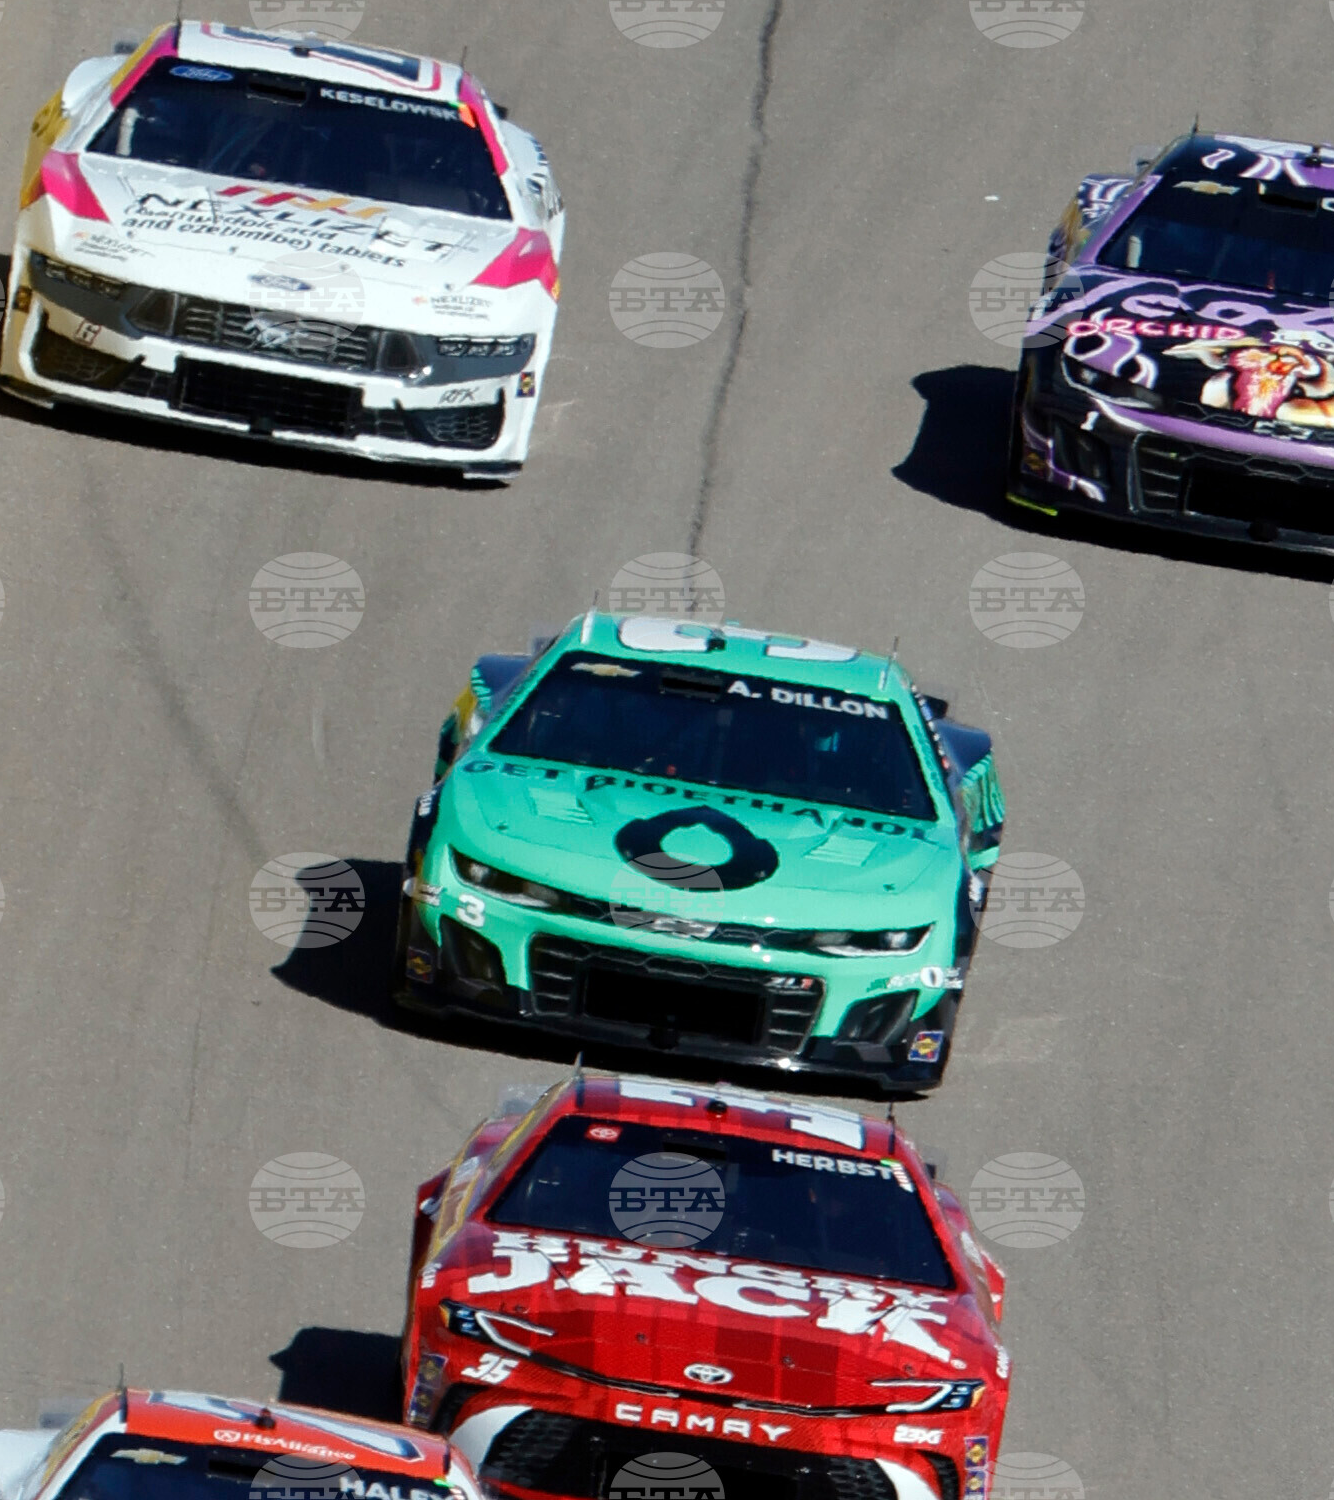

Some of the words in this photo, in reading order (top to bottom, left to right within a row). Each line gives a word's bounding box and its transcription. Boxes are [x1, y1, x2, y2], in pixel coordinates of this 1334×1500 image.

[320, 87, 462, 121] KESELOWSK
[121, 216, 174, 233] and
[1069, 317, 1247, 341] ORCHID
[1080, 411, 1100, 431] 1
[727, 679, 763, 699] A.
[770, 686, 889, 720] DILLON
[463, 759, 561, 780] GET
[584, 774, 936, 842] BIOETHANOL
[455, 892, 486, 928] 3
[771, 1148, 891, 1182] HERBST
[468, 1249, 952, 1363] JACK
[461, 1352, 519, 1386] 35
[614, 1402, 792, 1442] CAMRY
